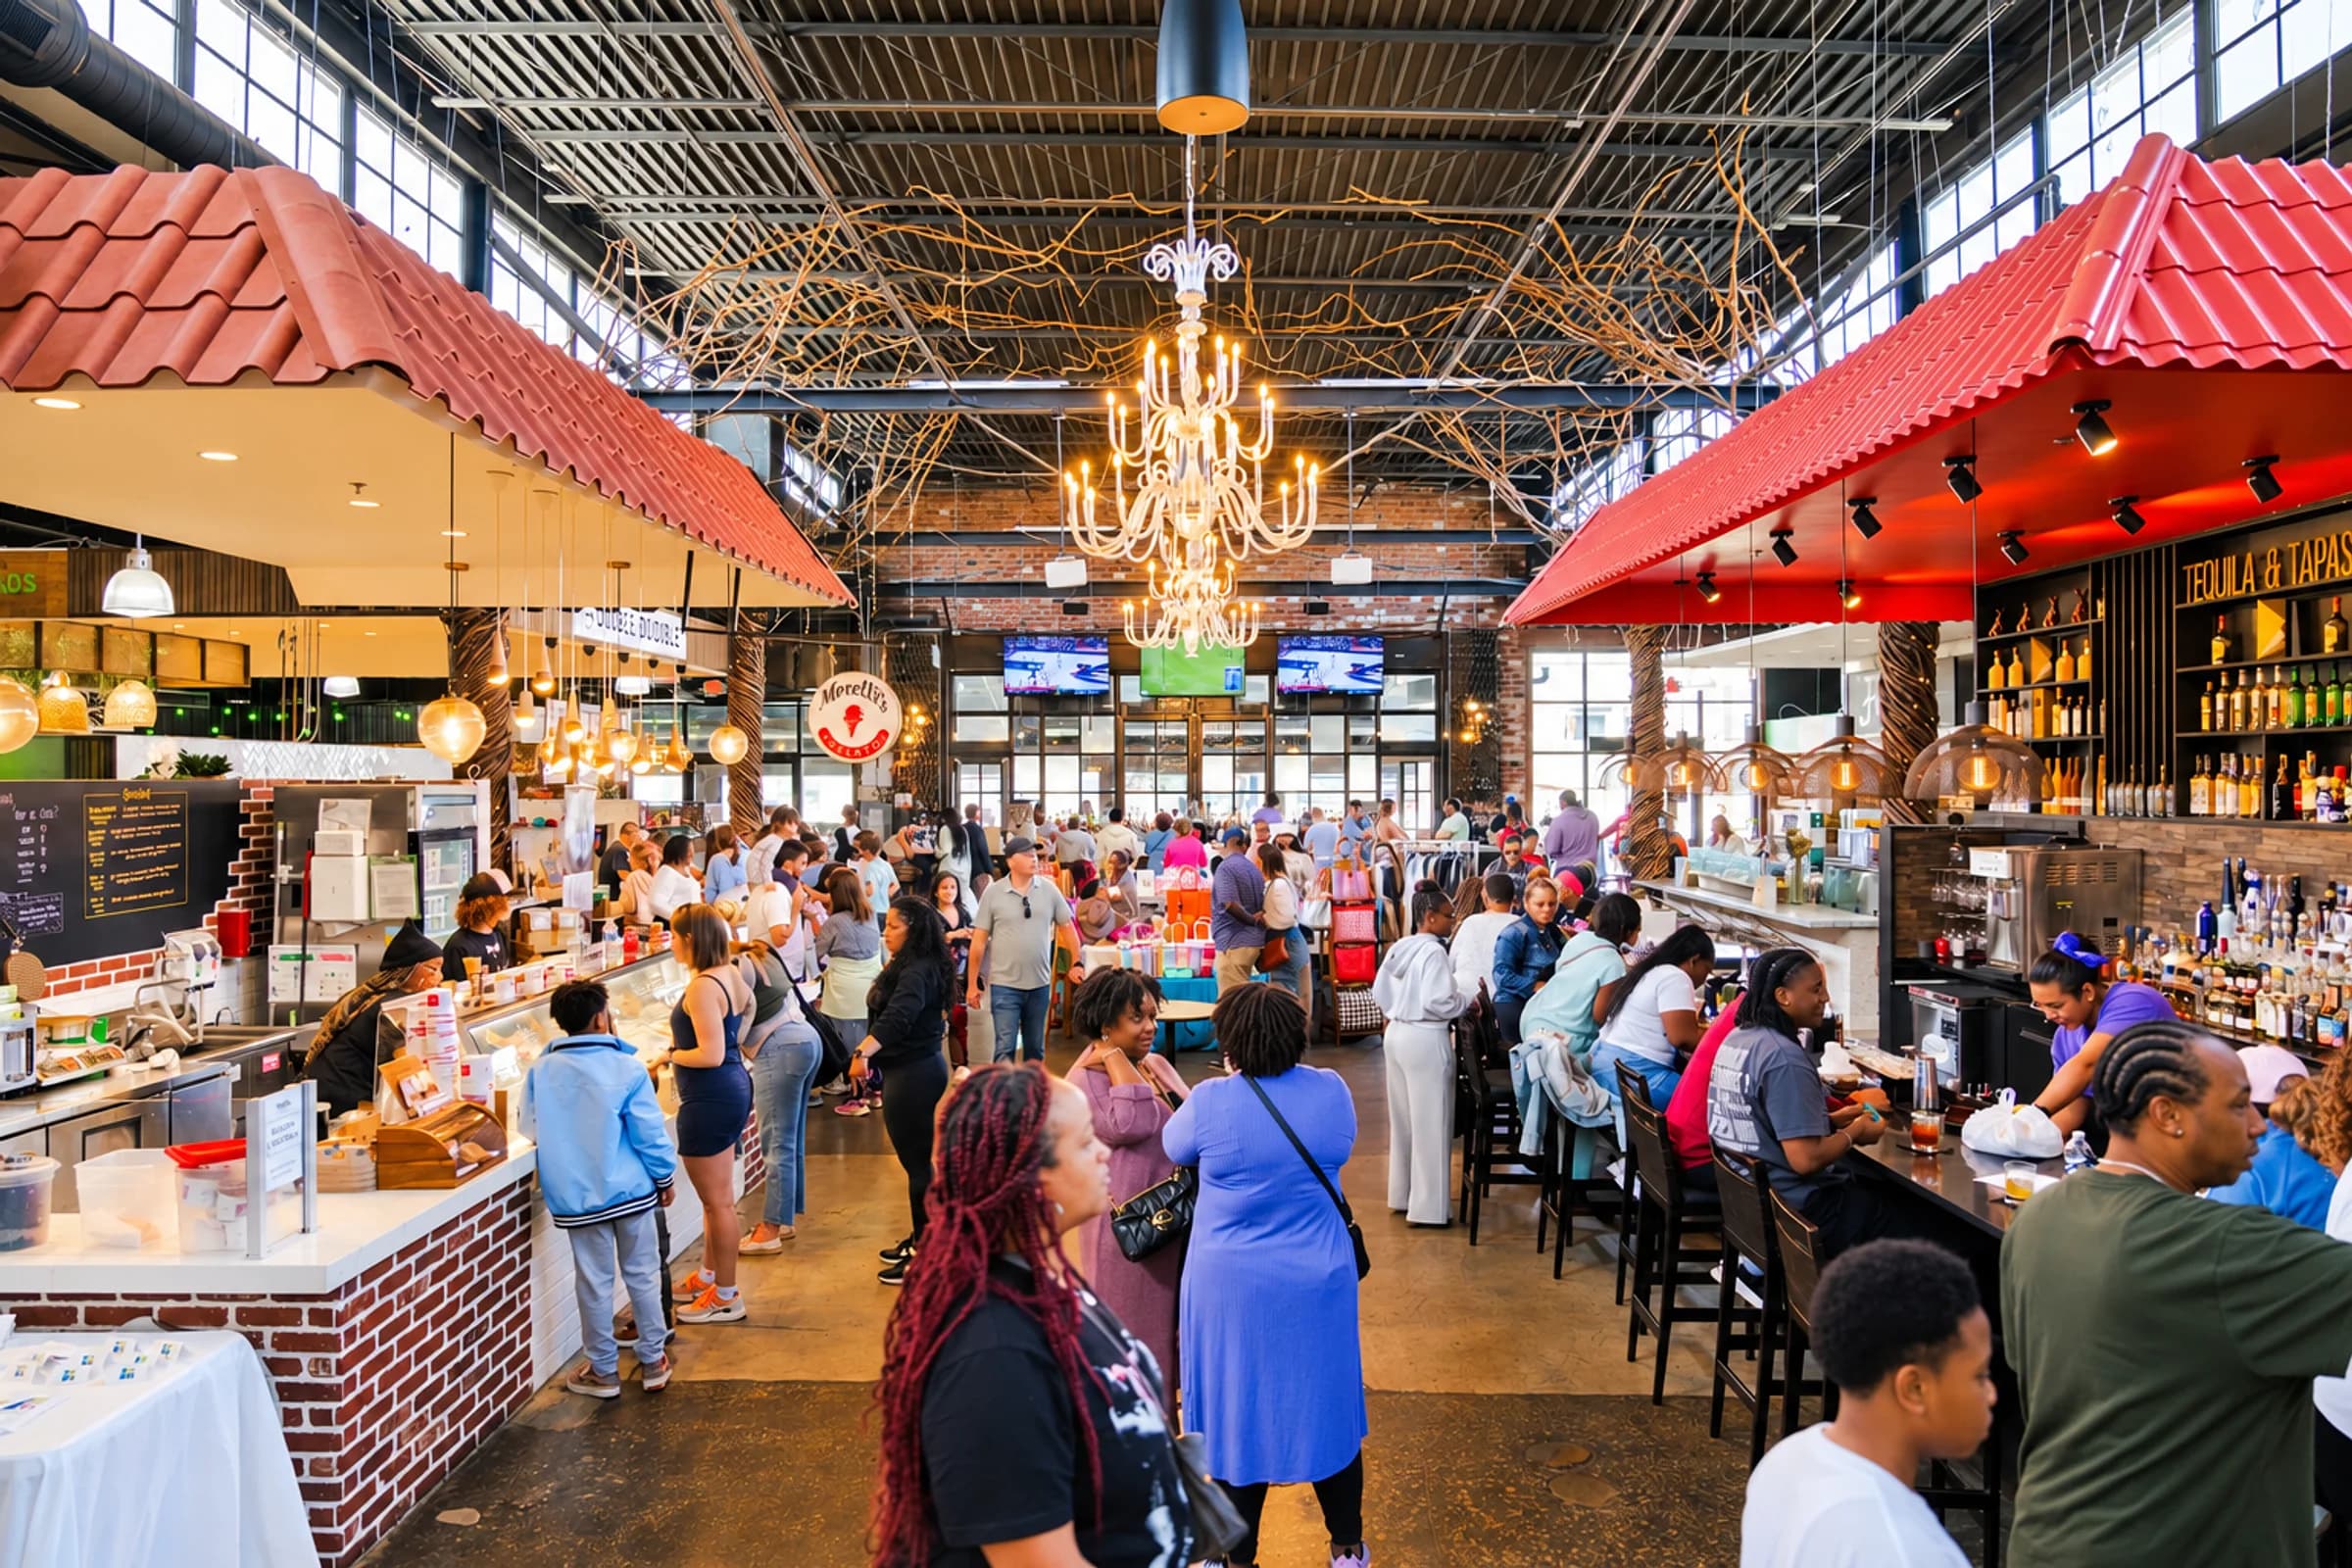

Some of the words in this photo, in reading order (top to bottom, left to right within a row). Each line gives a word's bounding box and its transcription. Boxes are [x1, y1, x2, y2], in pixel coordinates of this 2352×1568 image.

[2181, 551, 2255, 605] TEQUILA
[2264, 547, 2281, 589] &
[2287, 530, 2352, 586] TAPAS
[818, 680, 888, 713] Morelli's
[828, 739, 881, 758] GELATO
